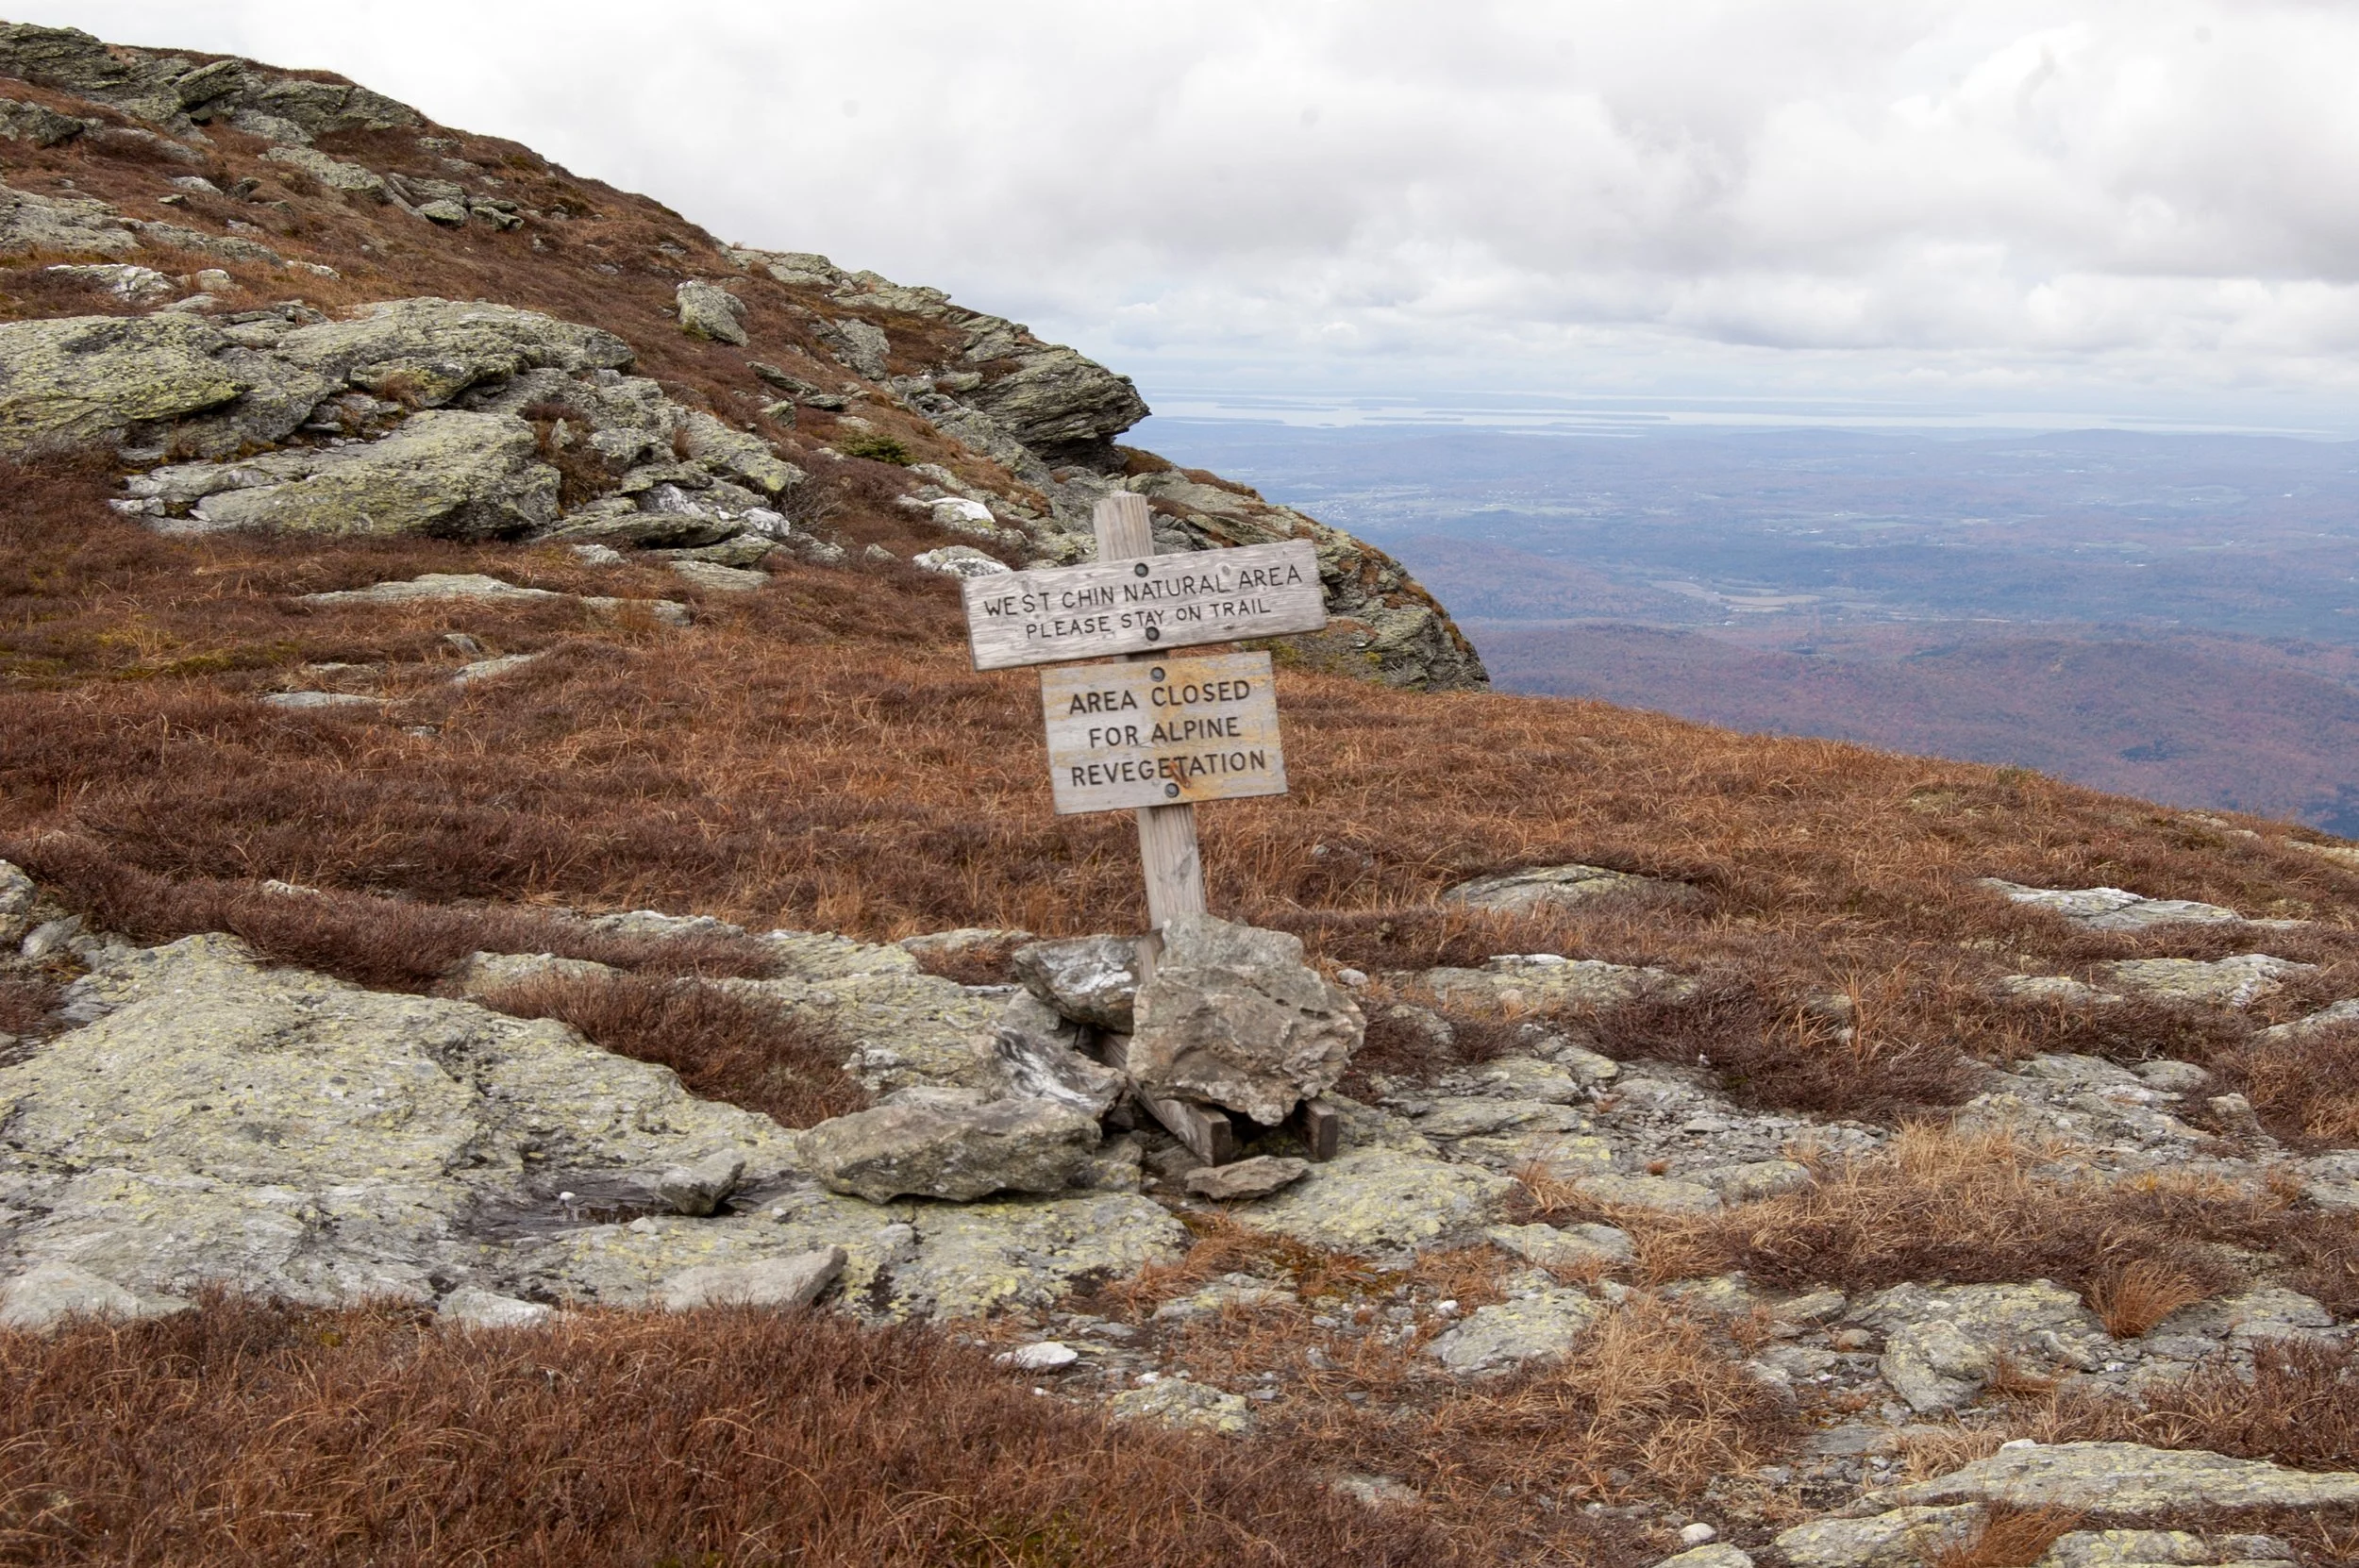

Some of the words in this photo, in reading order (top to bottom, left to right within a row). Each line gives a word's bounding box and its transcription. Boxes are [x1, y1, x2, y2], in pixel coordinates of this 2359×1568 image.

[983, 592, 1050, 616] WEST
[1062, 586, 1114, 609] CHIN
[1124, 575, 1230, 602] NATURAL
[1239, 564, 1302, 589] AREA
[1026, 616, 1111, 640] PLEASE
[1121, 609, 1164, 628] STAY
[1176, 606, 1201, 621] ON
[1210, 598, 1271, 618] TRAIL
[1069, 690, 1138, 715] AREA
[1151, 680, 1250, 707] CLOSED
[1089, 726, 1138, 748] FOR
[1151, 717, 1241, 743] ALPINE
[1071, 750, 1265, 787] REVEGETATION
